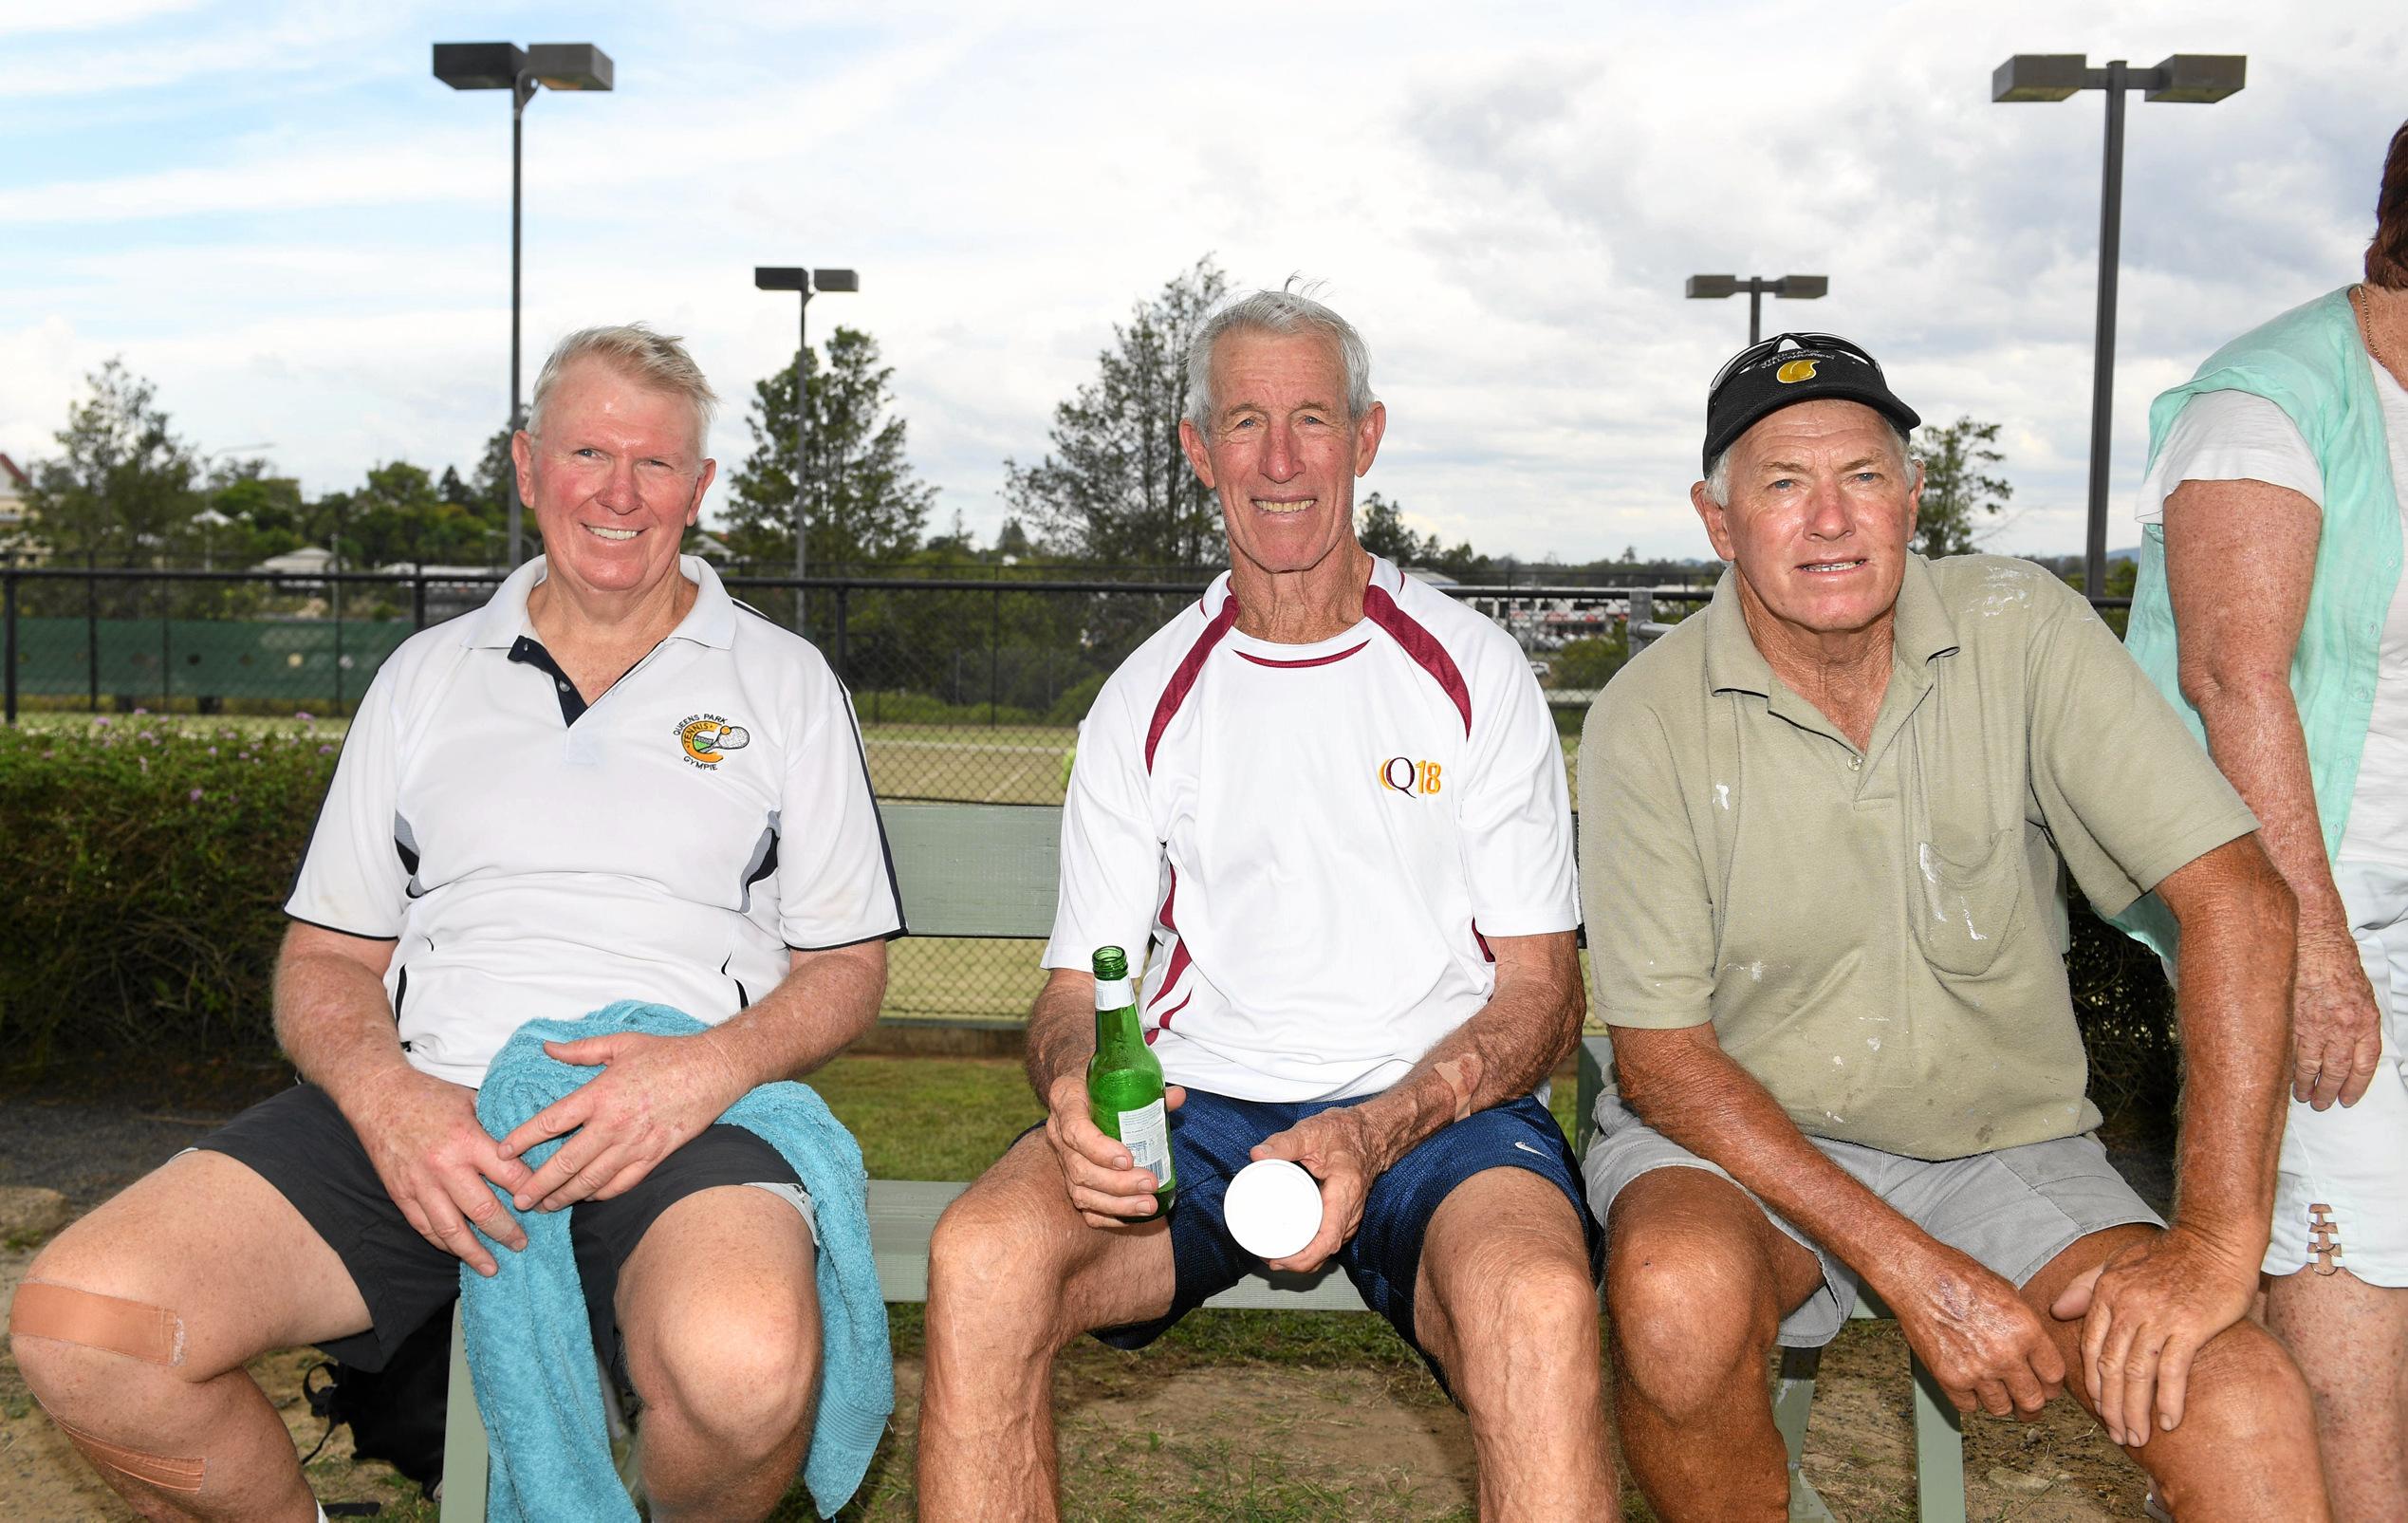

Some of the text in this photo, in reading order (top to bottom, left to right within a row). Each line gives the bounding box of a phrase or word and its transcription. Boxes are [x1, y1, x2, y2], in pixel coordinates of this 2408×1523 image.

[673, 714, 728, 735] QUEENS PARK
[683, 722, 709, 744] TENNIS
[683, 755, 718, 771] GYMPIE
